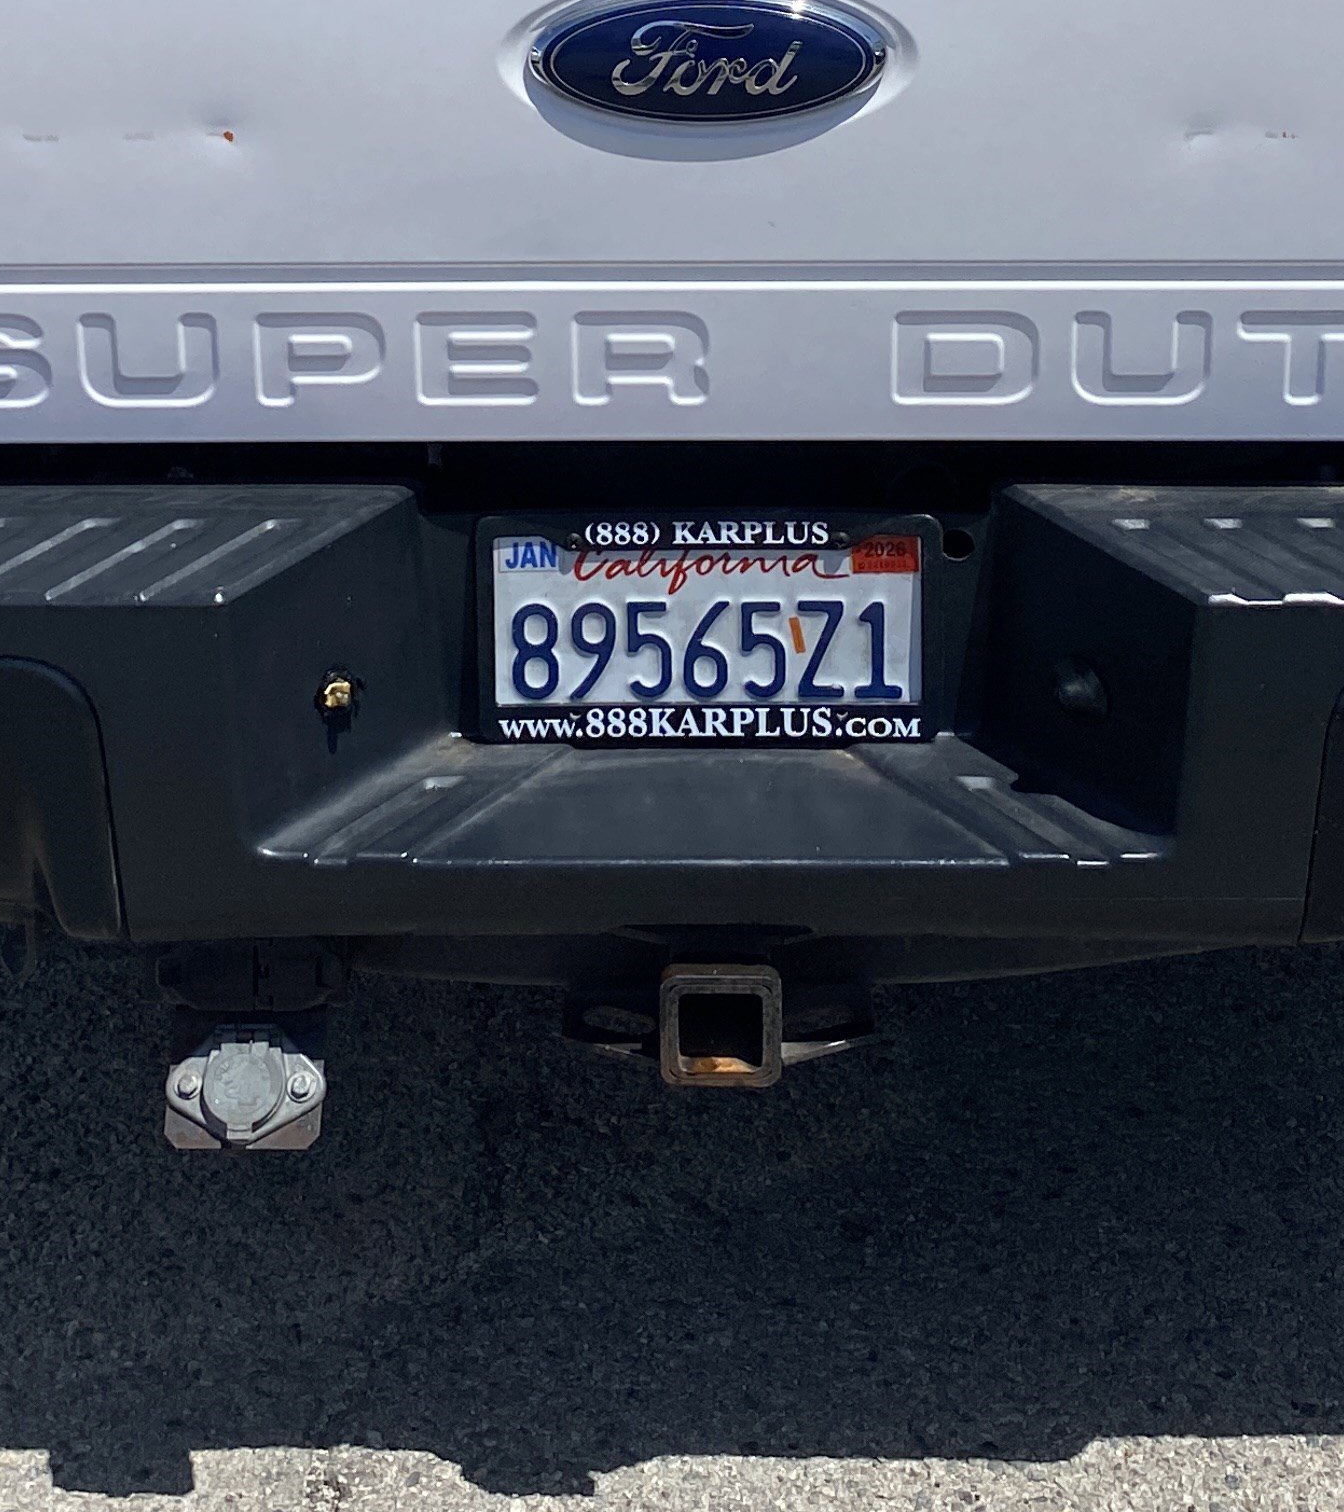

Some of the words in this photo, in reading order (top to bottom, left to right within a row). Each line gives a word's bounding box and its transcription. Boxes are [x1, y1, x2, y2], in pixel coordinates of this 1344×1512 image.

[612, 20, 804, 96] Ford
[585, 521, 661, 546] (888)
[672, 521, 830, 545] KARPLUS
[864, 541, 907, 558] 2026
[506, 541, 557, 569] JAN
[574, 547, 850, 595] California
[512, 601, 903, 700] 89565Z1
